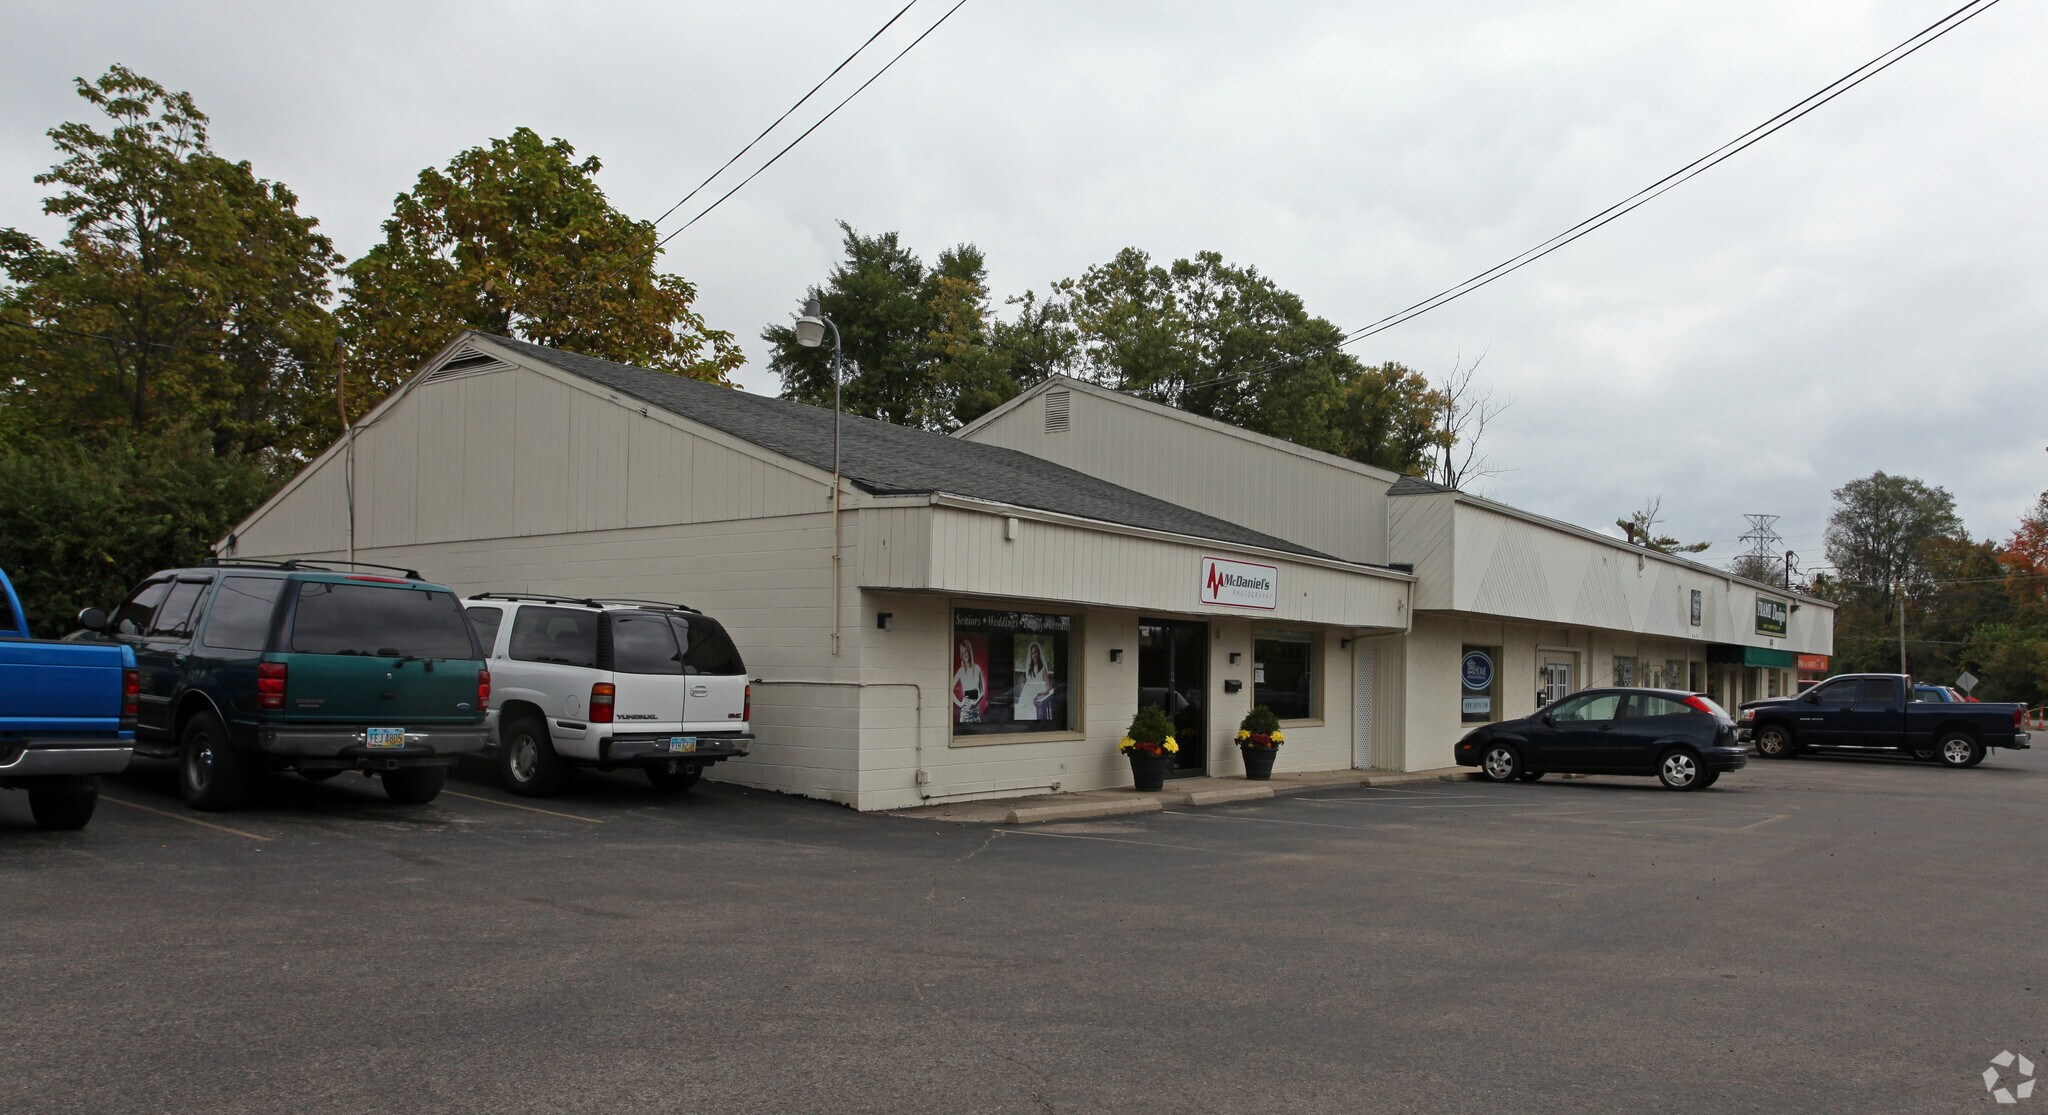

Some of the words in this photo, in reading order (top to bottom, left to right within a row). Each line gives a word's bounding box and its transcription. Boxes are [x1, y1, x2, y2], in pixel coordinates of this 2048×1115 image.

[1225, 573, 1270, 590] McDaniel's
[1233, 589, 1272, 600] PHOTOGRAPHY
[955, 612, 981, 627] Seniors
[988, 614, 1019, 630] Weddings
